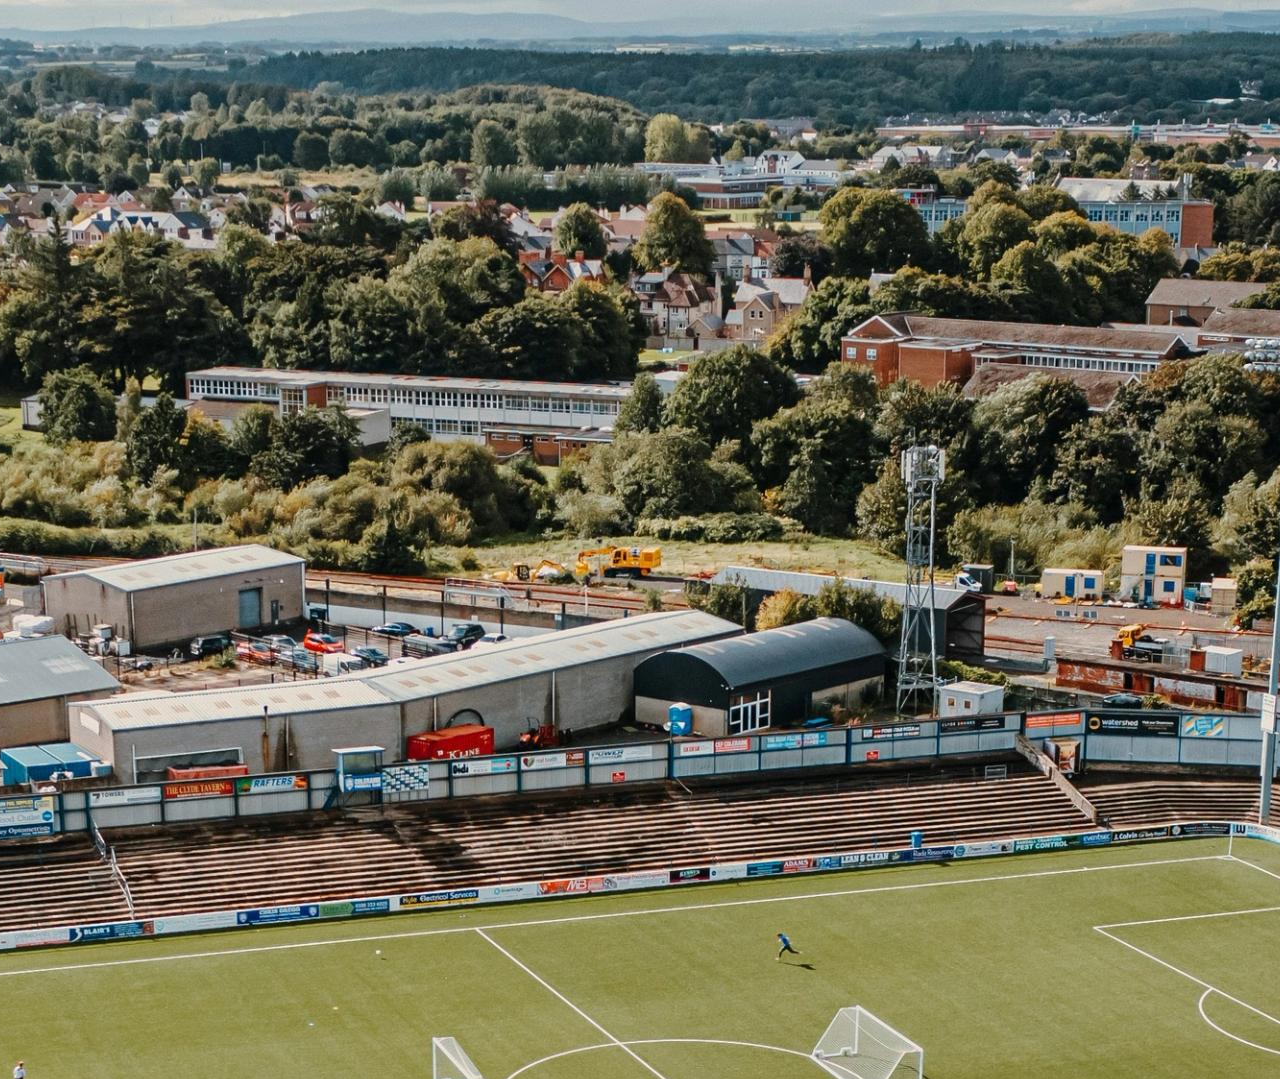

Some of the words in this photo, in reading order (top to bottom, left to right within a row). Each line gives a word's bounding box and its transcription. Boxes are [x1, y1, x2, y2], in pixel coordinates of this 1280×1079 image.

[1102, 718, 1138, 727] watershed
[254, 777, 293, 788] RAFTERS
[166, 786, 178, 795] THE
[179, 784, 199, 794] CLYDE
[200, 782, 226, 793] TAVERN
[1119, 831, 1138, 839] Colvin
[1015, 843, 1034, 852] PEST
[1035, 841, 1069, 850] CONTROL
[784, 859, 809, 868] ADAMS
[841, 855, 860, 864] LEAN
[866, 852, 889, 862] CLEAN
[419, 893, 449, 902] Electrical
[449, 890, 477, 899] Services
